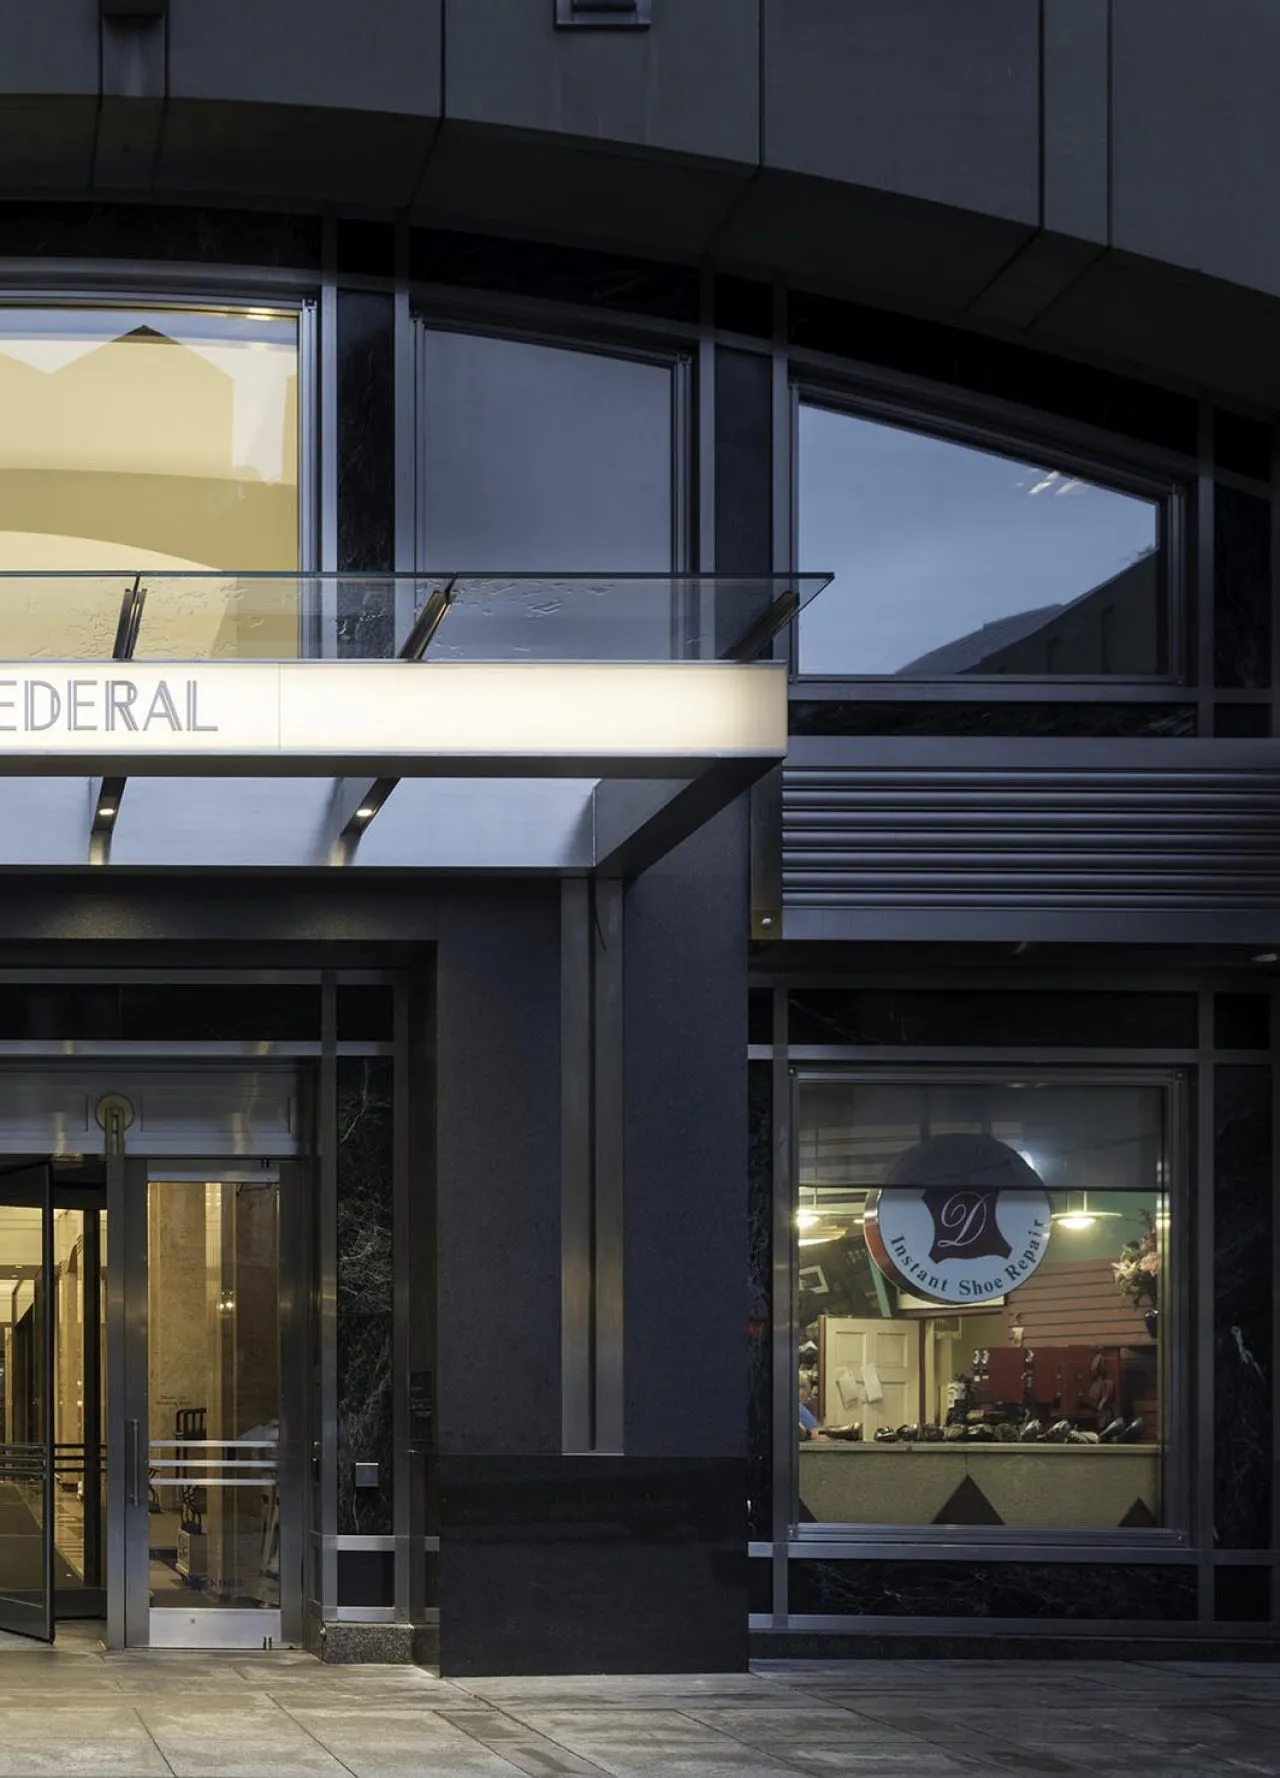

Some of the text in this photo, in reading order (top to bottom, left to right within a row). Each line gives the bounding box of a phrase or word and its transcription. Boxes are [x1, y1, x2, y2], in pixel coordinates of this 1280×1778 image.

[891, 1217, 1045, 1297] Instant Shoe Repair
